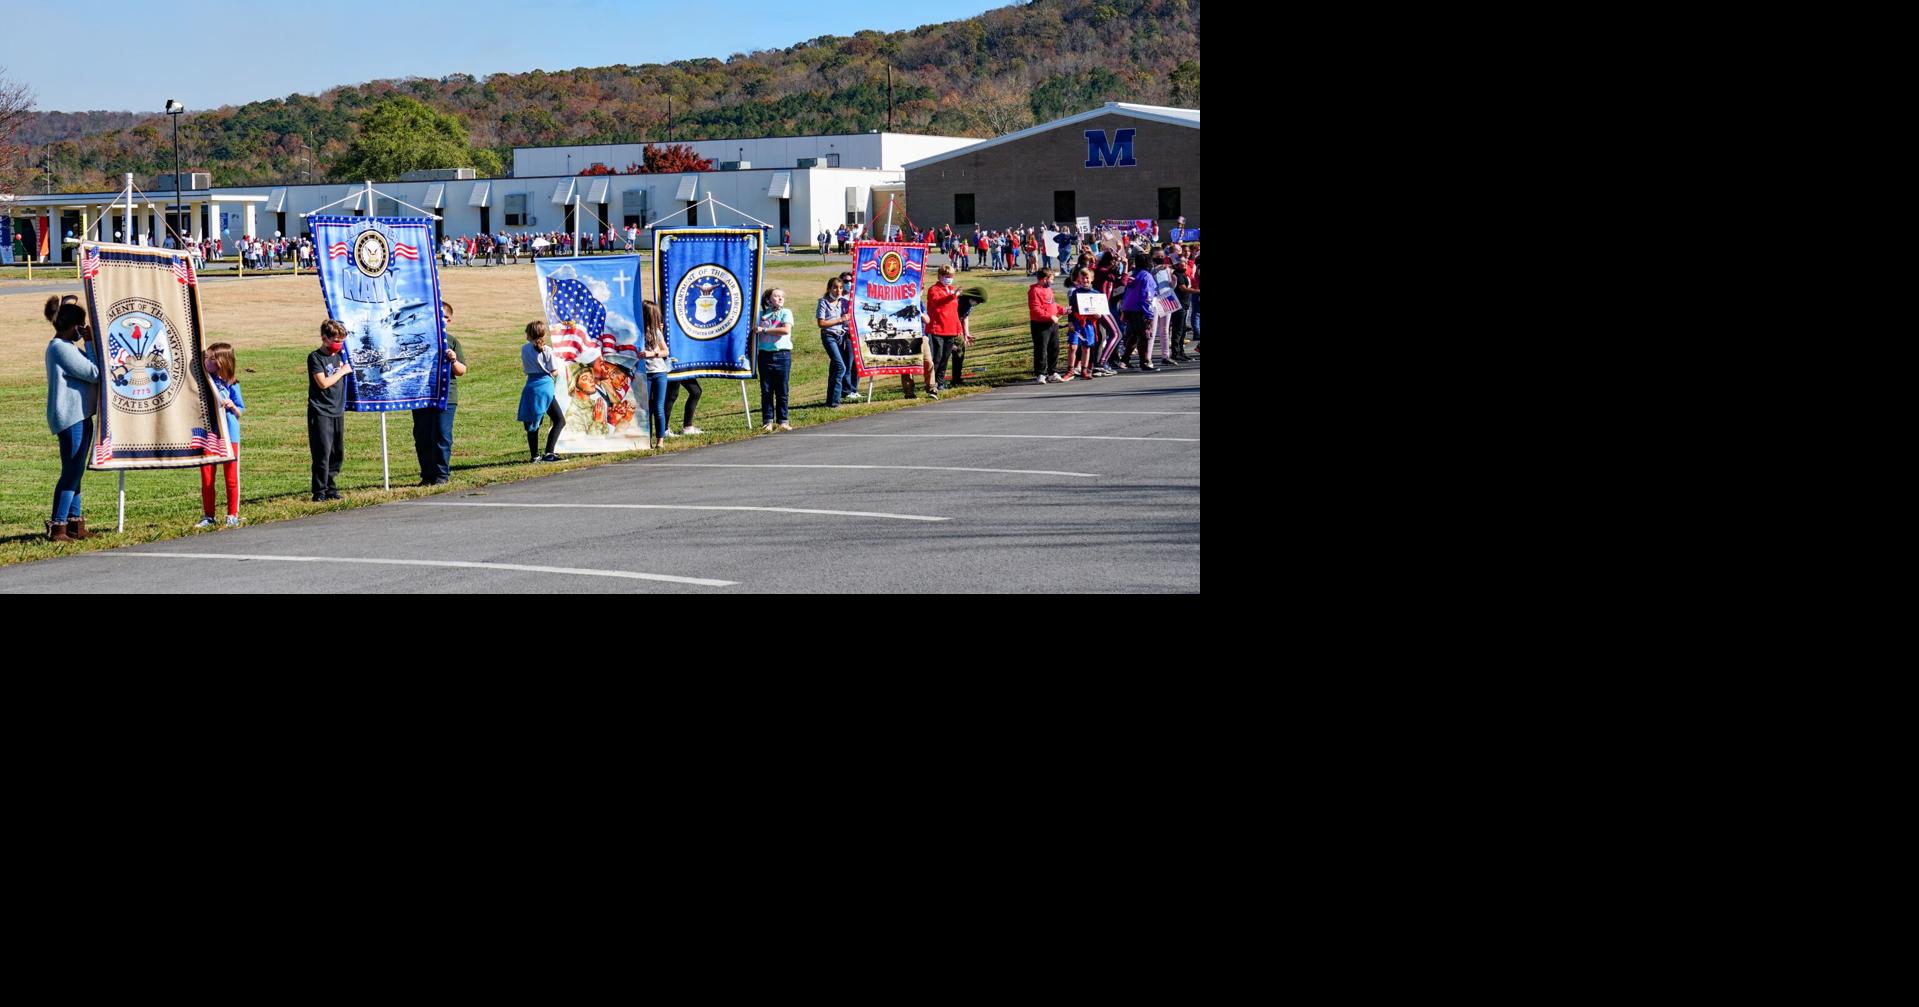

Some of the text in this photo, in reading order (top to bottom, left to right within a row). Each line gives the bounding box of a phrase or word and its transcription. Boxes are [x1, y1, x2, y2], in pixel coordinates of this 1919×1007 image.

[1084, 127, 1137, 169] M
[343, 267, 400, 304] NAVY
[867, 281, 916, 301] MARINES
[137, 303, 147, 311] OF
[113, 395, 149, 409] STATES
[152, 397, 165, 407] OF
